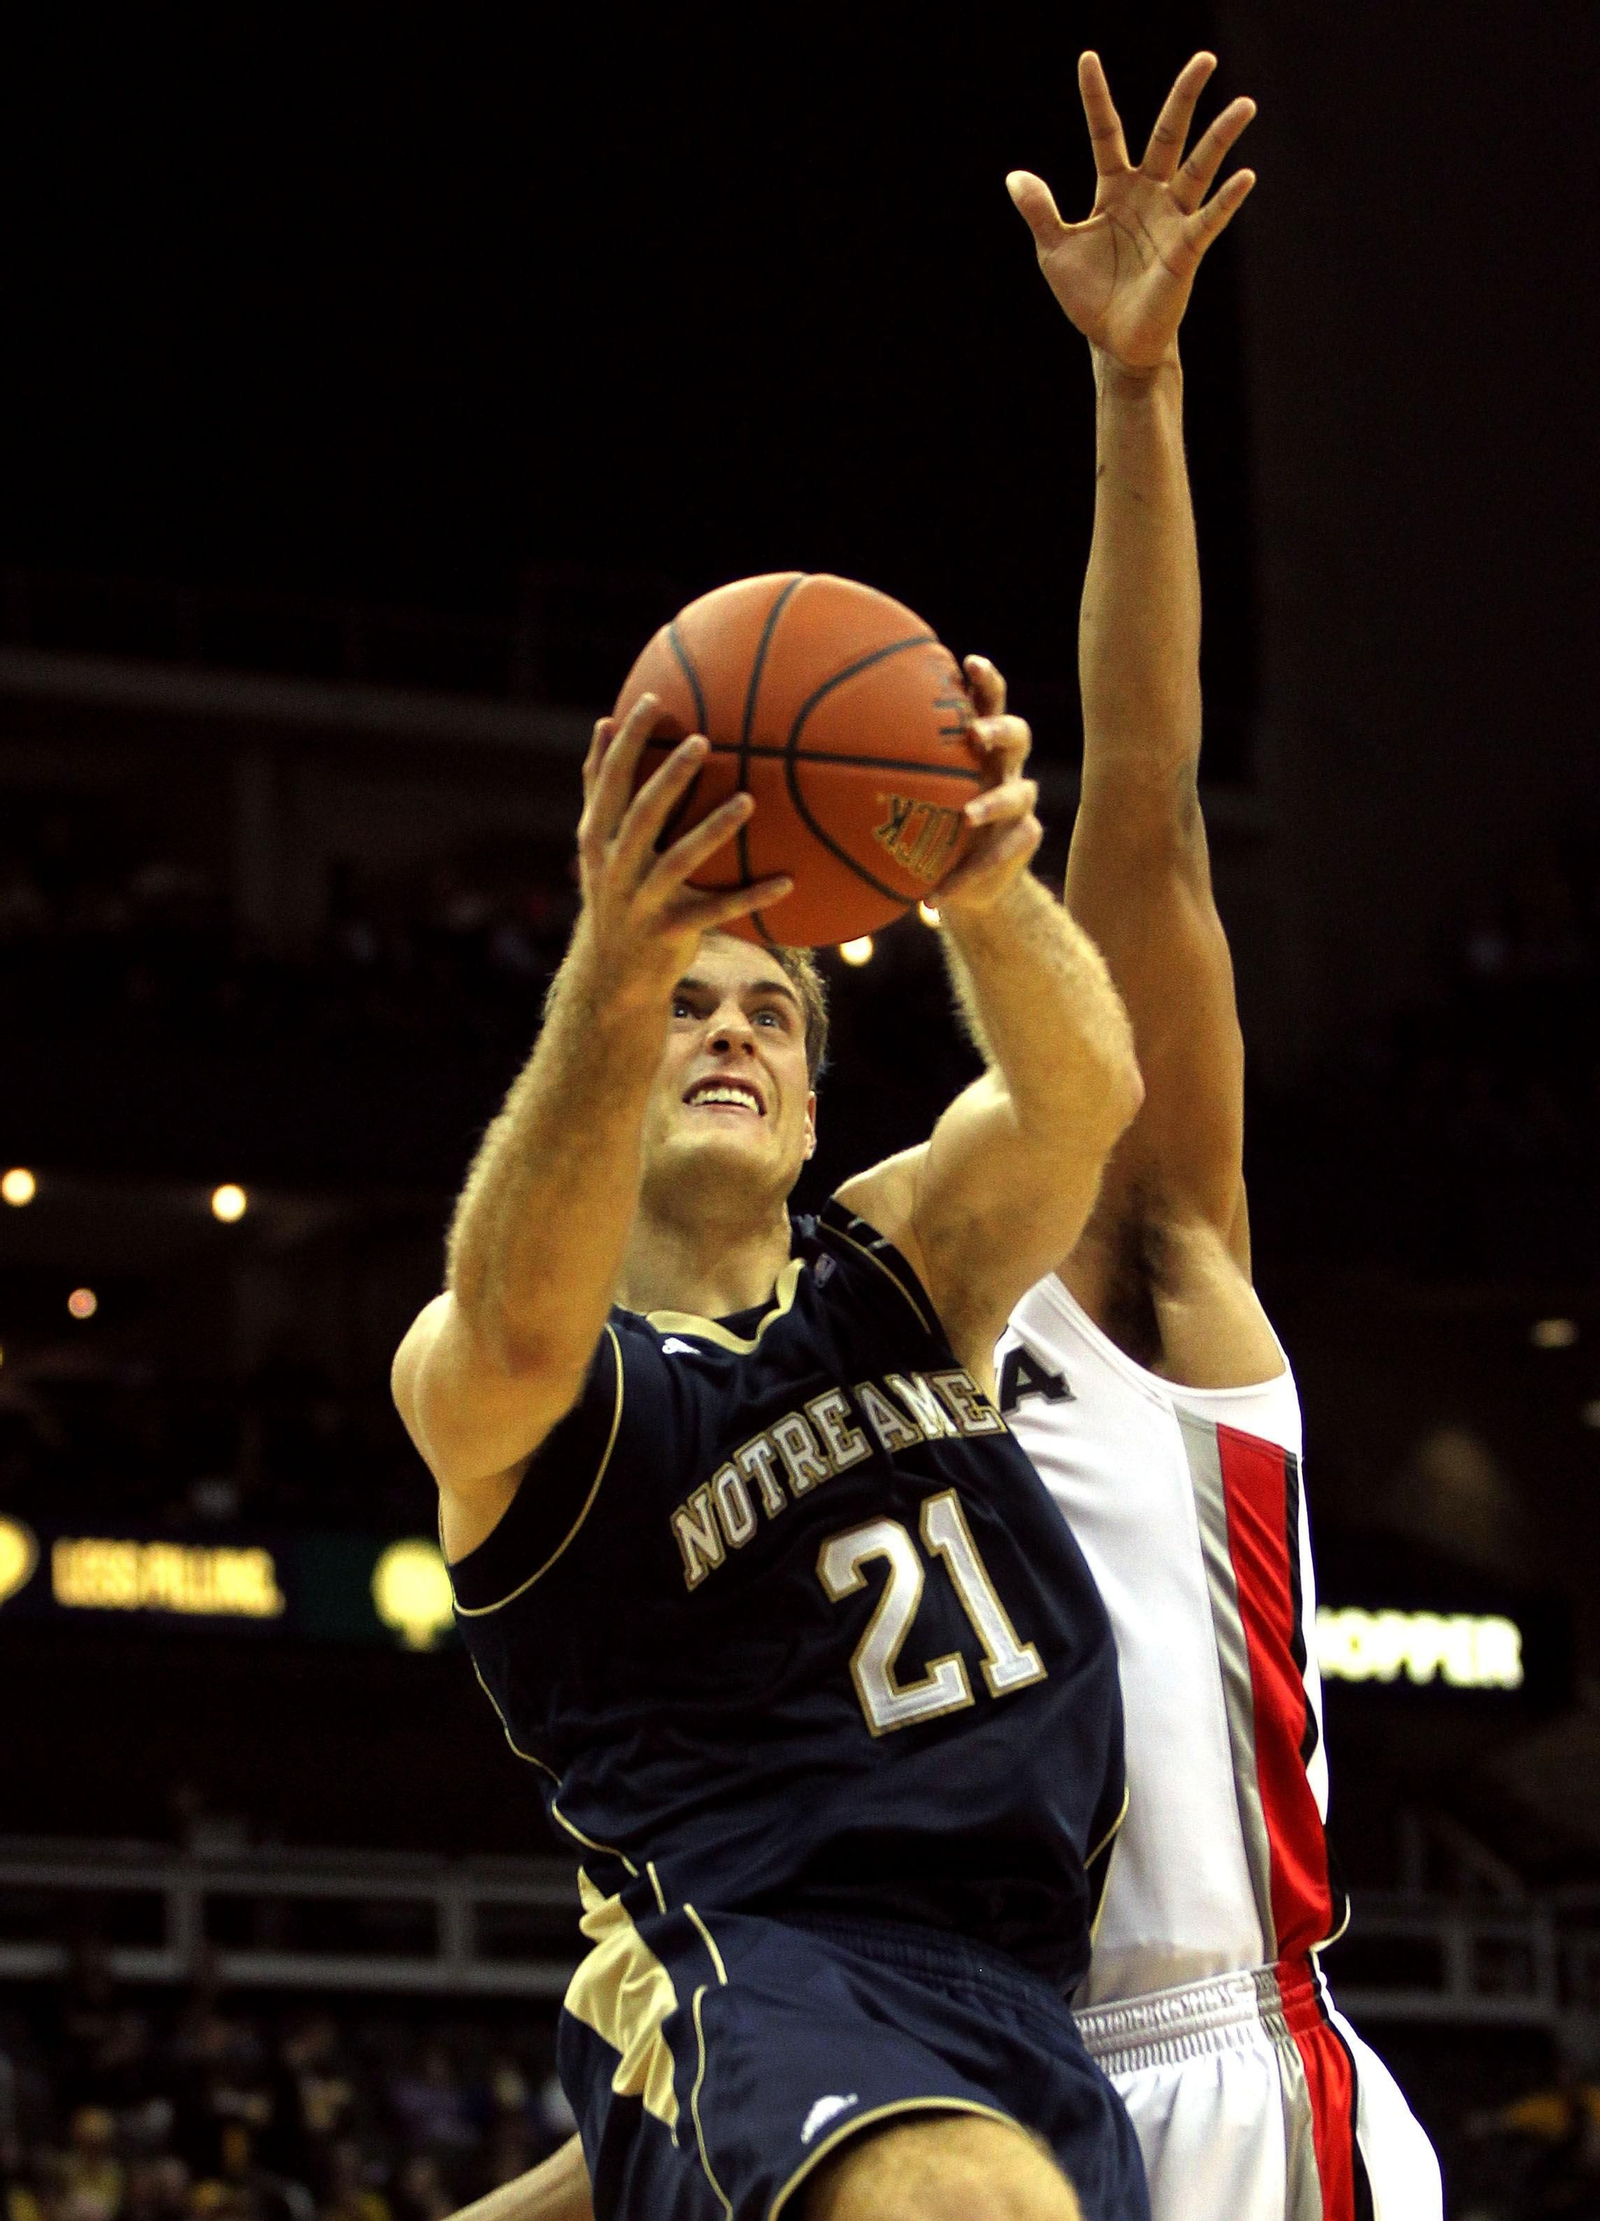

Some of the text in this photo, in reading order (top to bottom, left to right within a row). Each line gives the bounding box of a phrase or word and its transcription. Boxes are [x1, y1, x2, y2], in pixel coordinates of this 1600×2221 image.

[670, 1367, 1007, 1592] NOTRE AME
[816, 1487, 1048, 1738] 21
